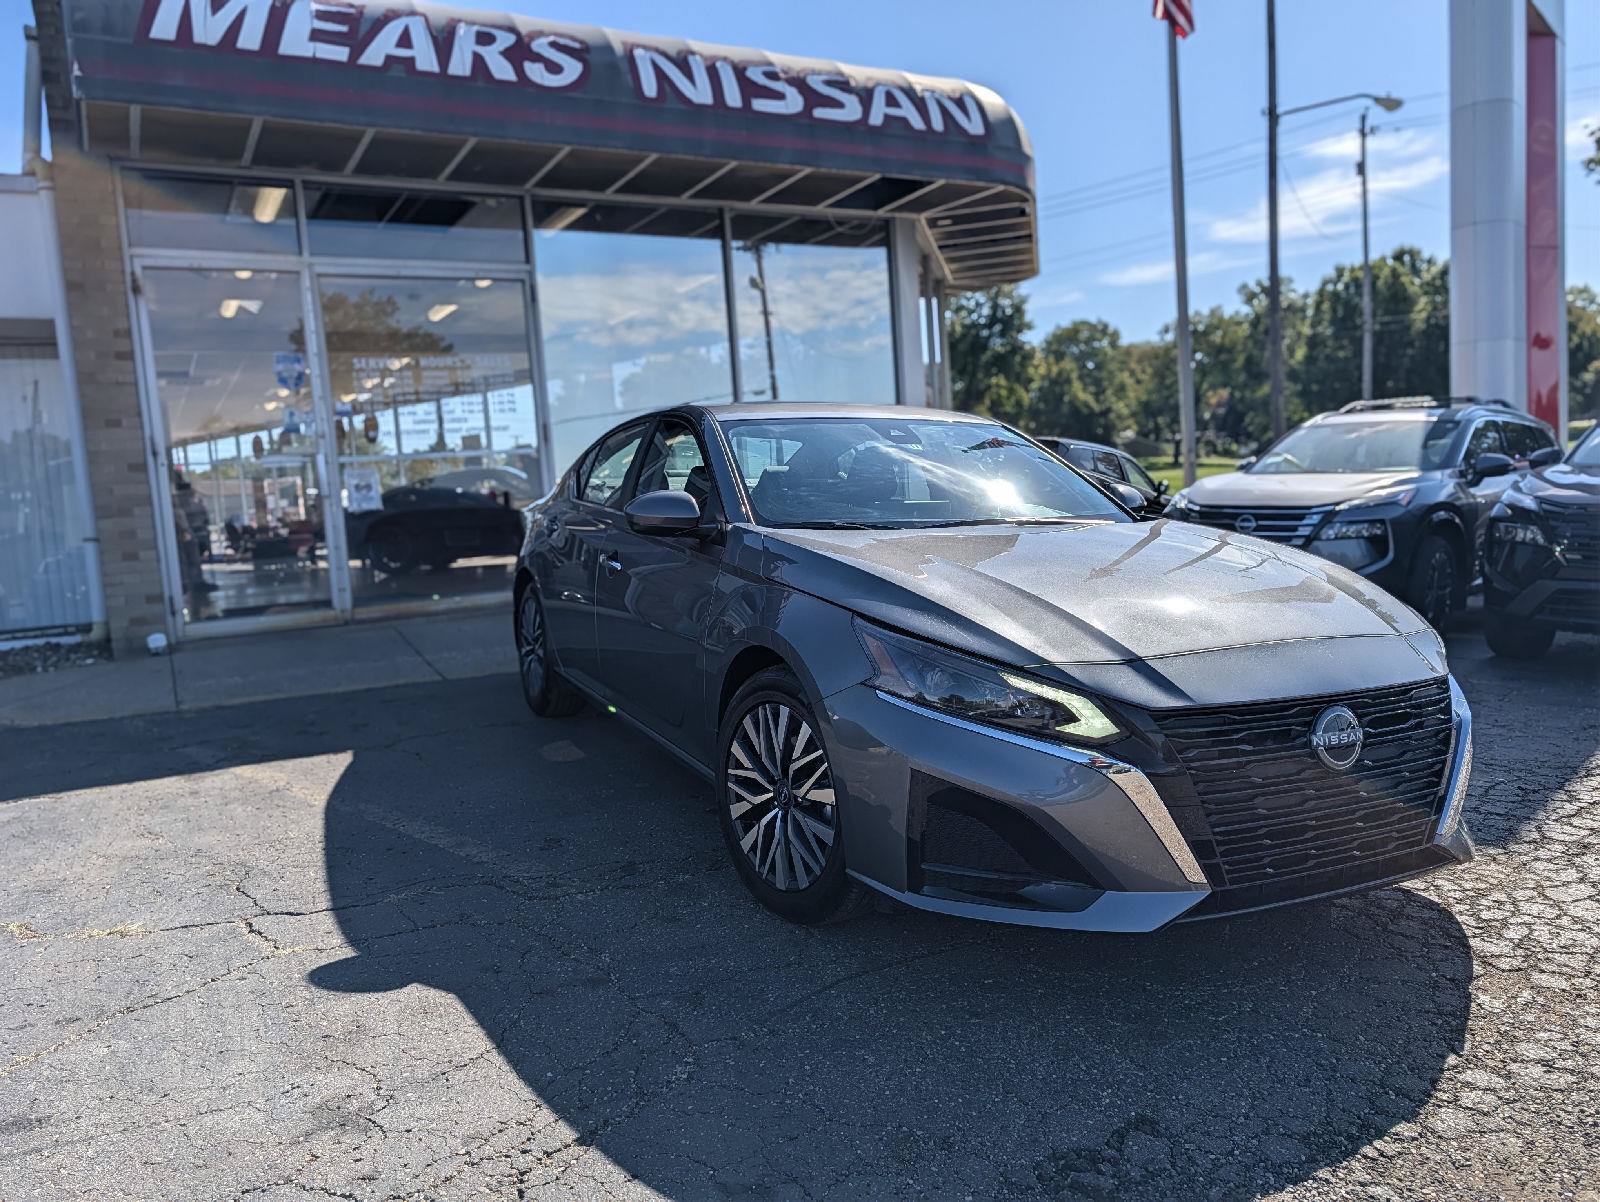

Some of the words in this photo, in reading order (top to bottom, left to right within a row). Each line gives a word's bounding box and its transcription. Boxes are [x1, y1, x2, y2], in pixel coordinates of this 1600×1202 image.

[149, 0, 585, 88] MEARS
[632, 47, 986, 136] NISSAN
[1312, 731, 1363, 746] NISSAN
